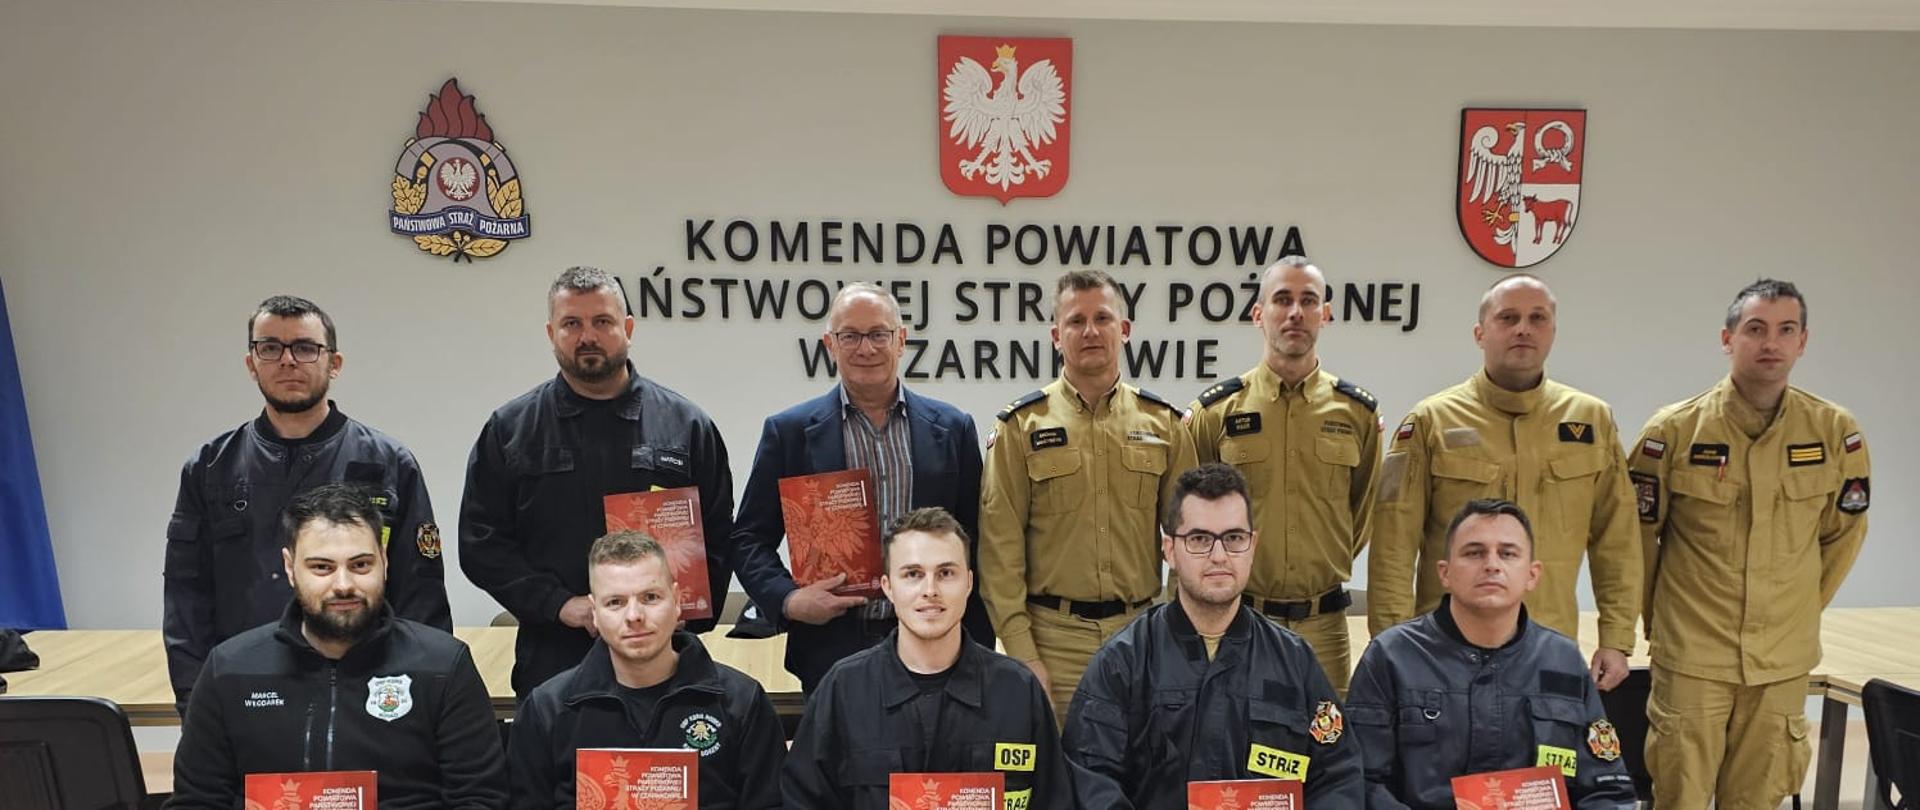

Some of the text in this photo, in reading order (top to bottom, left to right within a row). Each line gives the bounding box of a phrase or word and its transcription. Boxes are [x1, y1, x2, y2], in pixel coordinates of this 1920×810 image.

[393, 210, 524, 235] PAŃSTWOWA STRAŻ POŻARNA
[685, 219, 1307, 266] KOMENDA POWIATOWA
[955, 281, 1147, 322] STRY
[1000, 748, 1031, 766] OSP
